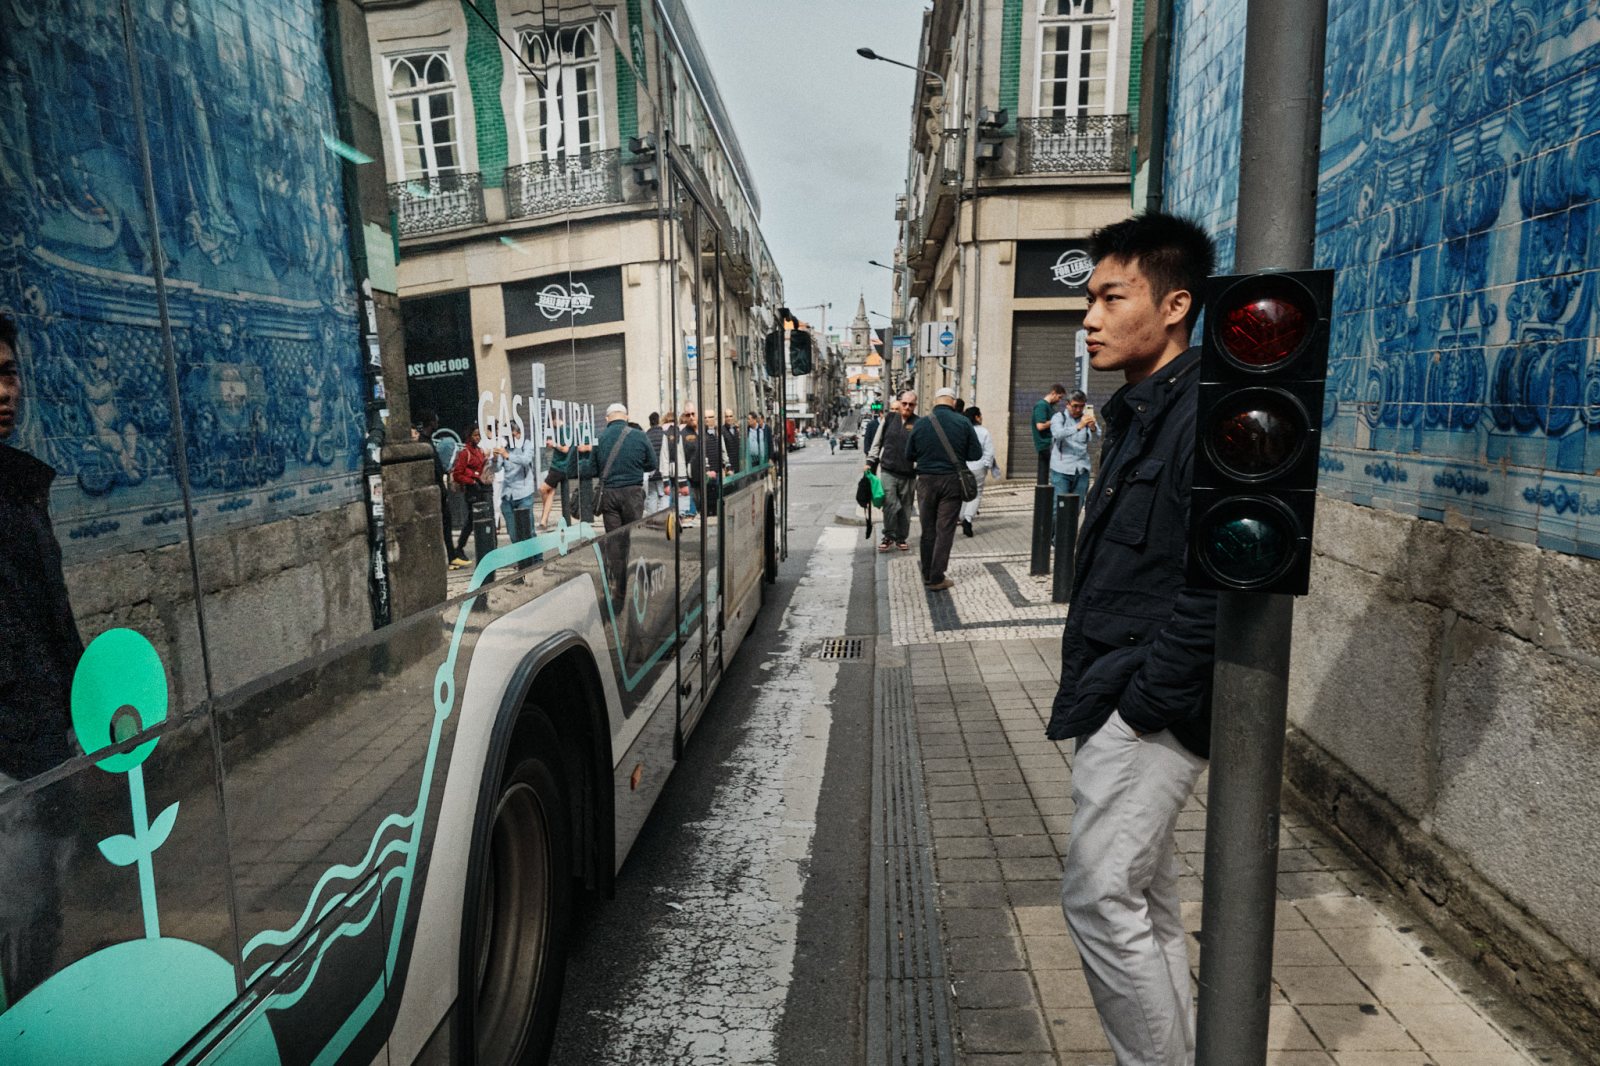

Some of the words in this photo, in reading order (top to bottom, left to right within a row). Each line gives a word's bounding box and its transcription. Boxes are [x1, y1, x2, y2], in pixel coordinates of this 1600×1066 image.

[1055, 265, 1070, 277] FOR
[478, 378, 525, 449] GÁS
[529, 396, 599, 448] NATURAL
